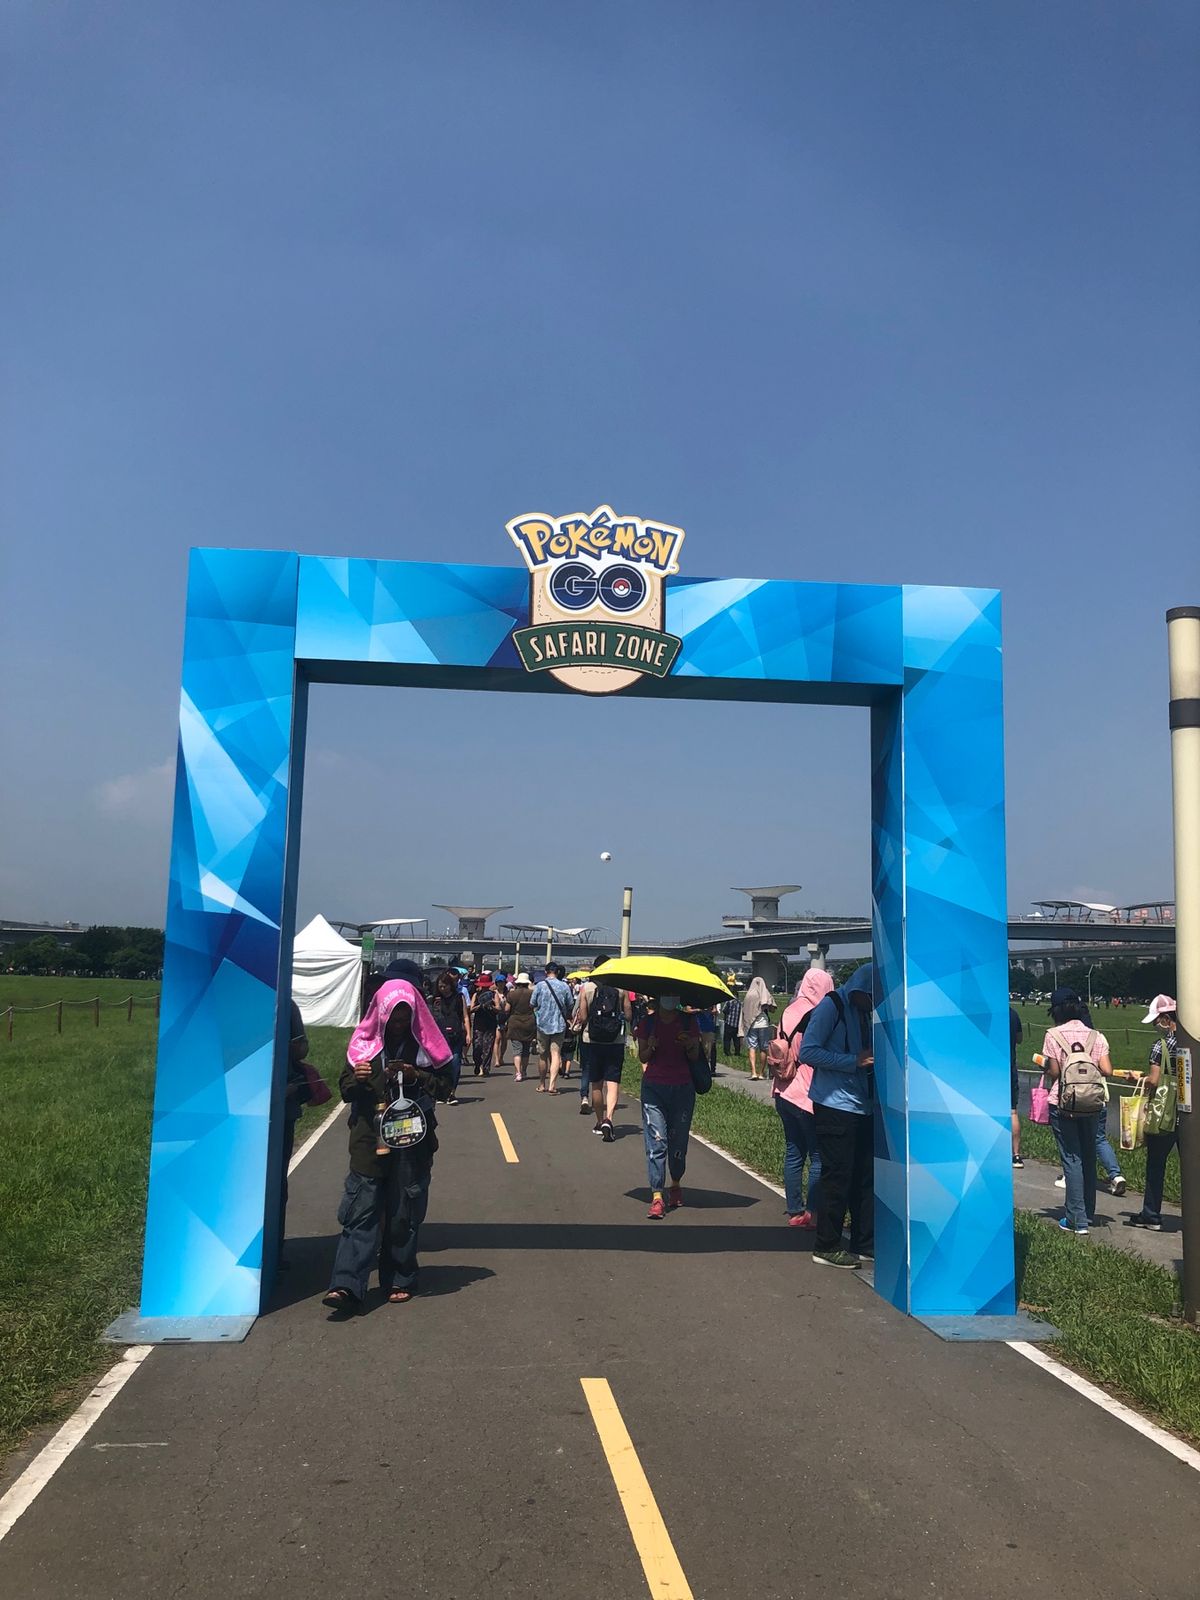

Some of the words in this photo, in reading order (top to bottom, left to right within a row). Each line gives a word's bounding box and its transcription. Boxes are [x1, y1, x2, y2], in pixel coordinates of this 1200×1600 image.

[550, 562, 647, 612] GO
[529, 631, 606, 662] SAFARI
[614, 633, 668, 667] ZONE
